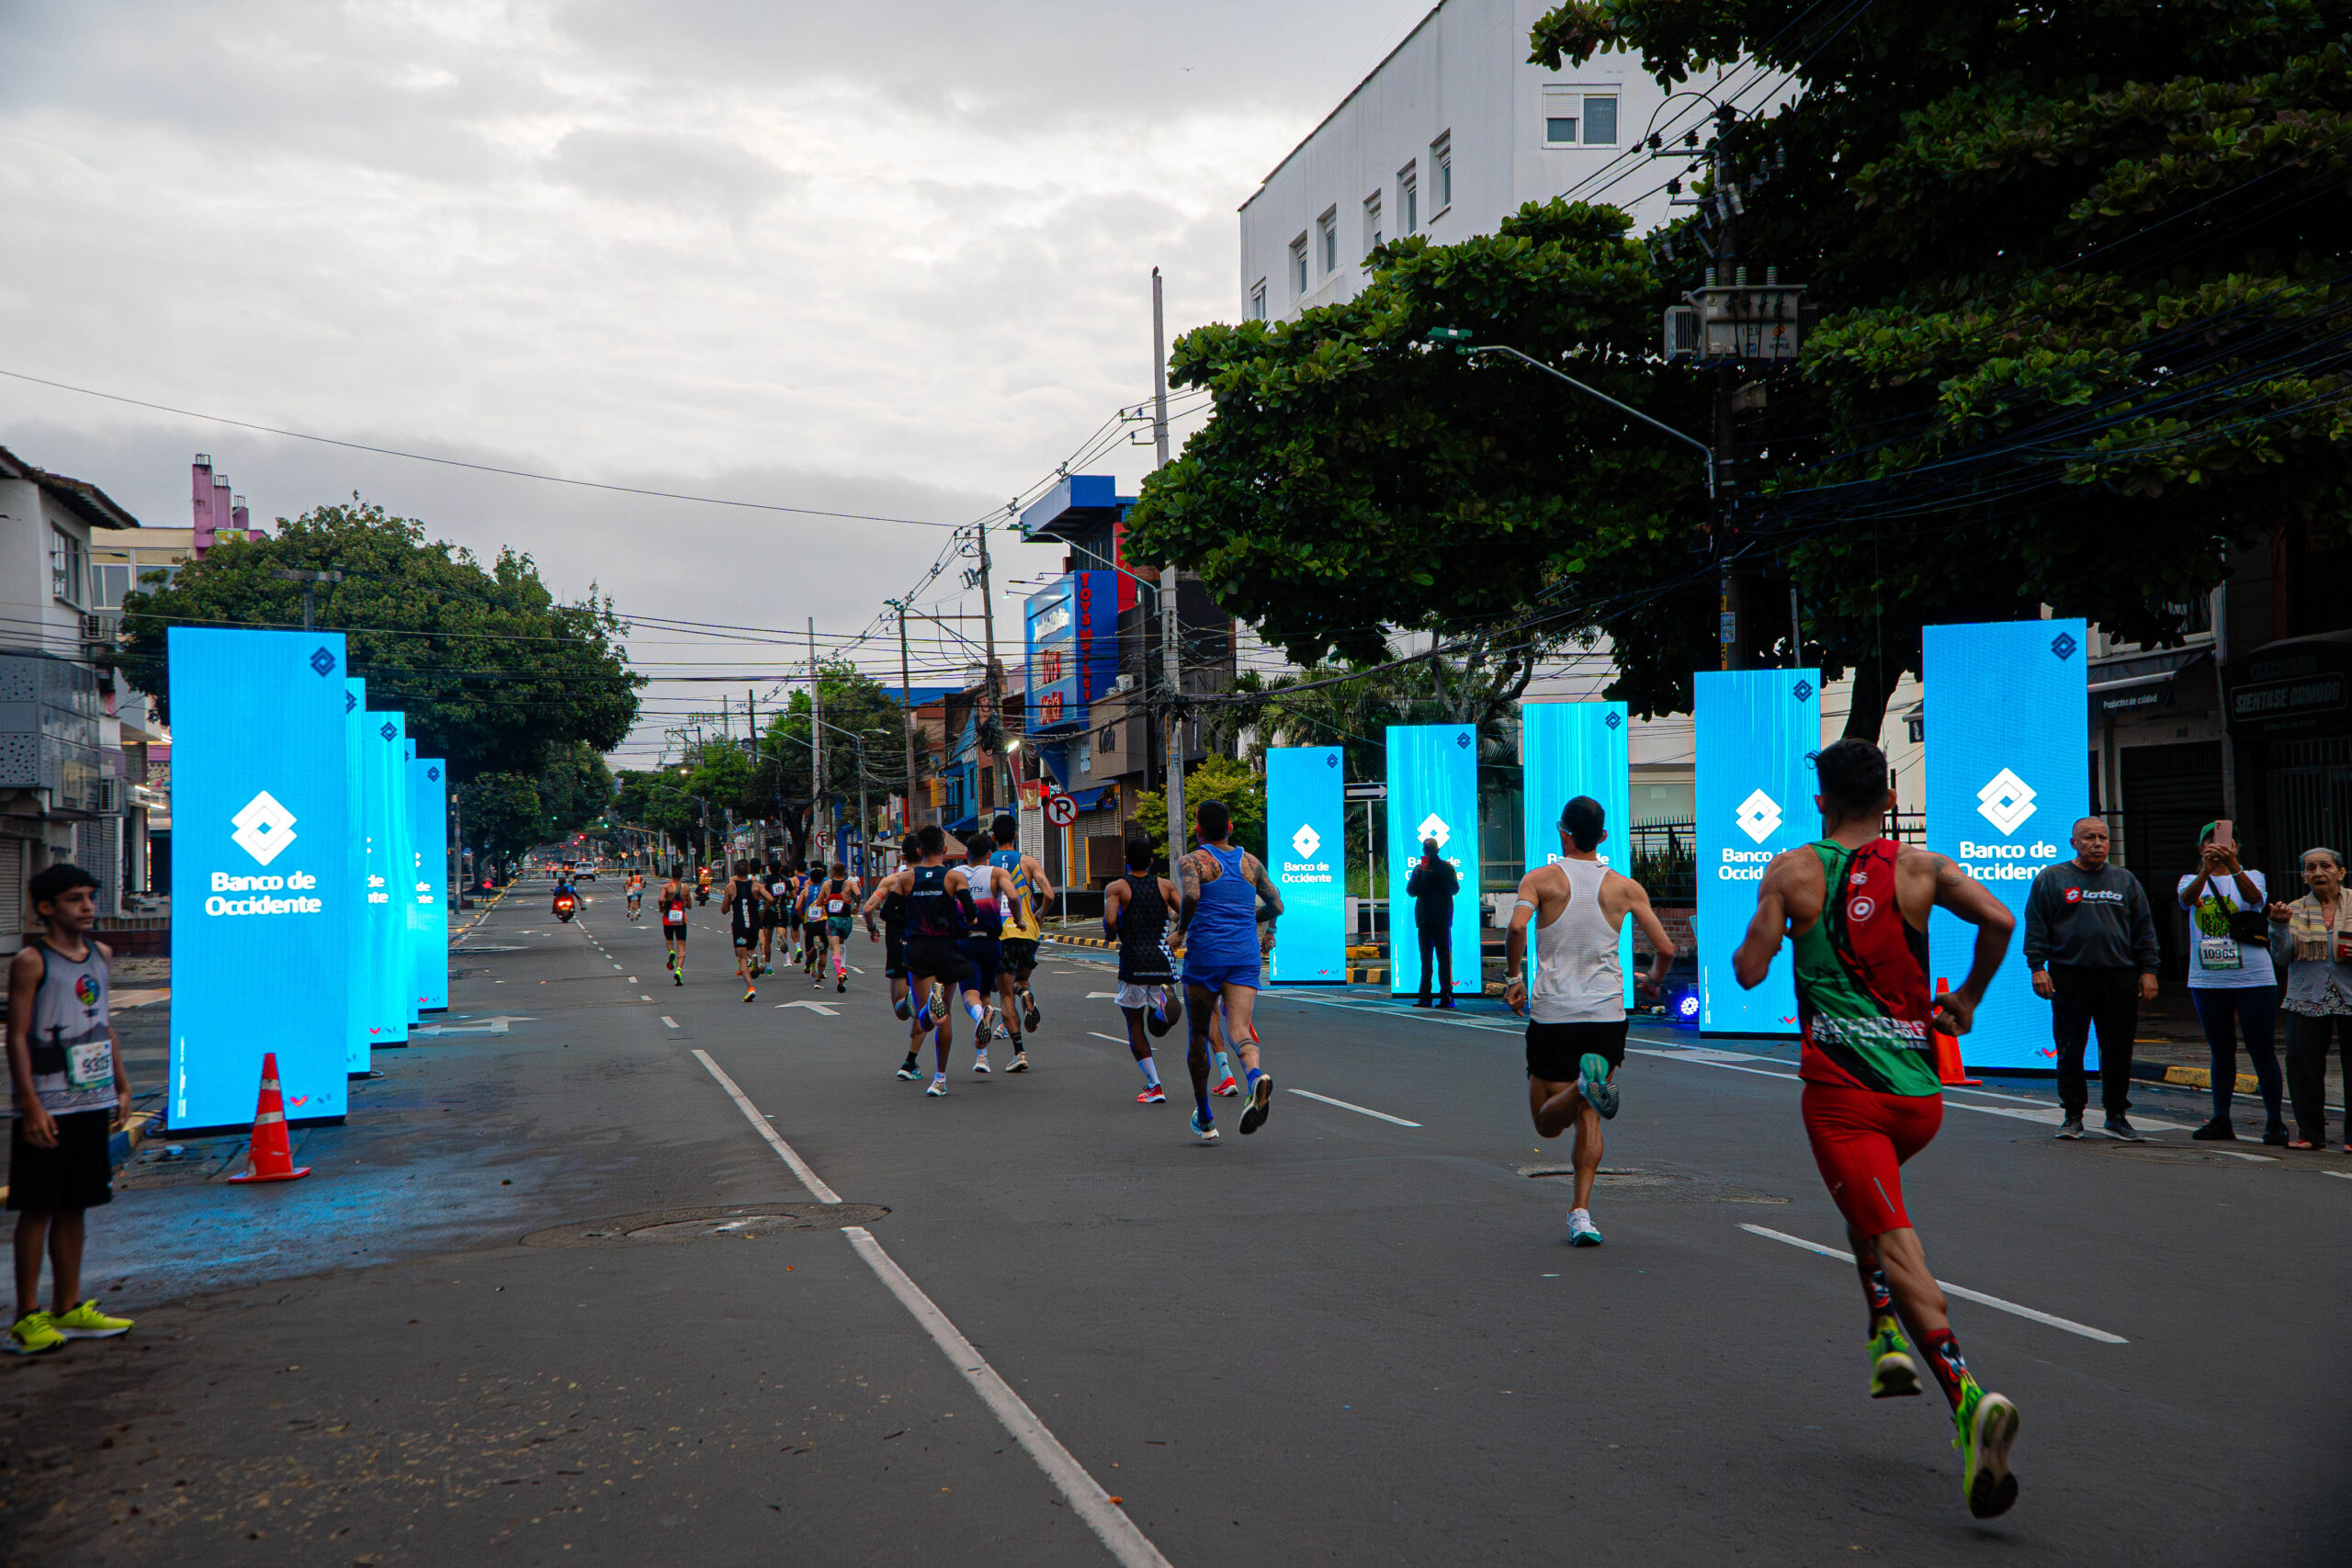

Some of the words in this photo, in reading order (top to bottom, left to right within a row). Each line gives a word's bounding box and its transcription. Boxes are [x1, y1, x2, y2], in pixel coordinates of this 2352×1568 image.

[1080, 572, 1091, 626] TOYS
[1722, 848, 1773, 863] Banco
[1959, 840, 2026, 859] Banco
[2029, 840, 2057, 858] de
[1283, 862, 1315, 872] Banco
[1317, 862, 1329, 872] de
[210, 872, 284, 892] Banco
[287, 870, 317, 890] de
[1282, 873, 1332, 883] Occidente
[2082, 889, 2123, 901] lotto
[205, 895, 322, 917] Occidente
[2203, 949, 2235, 959] 10965
